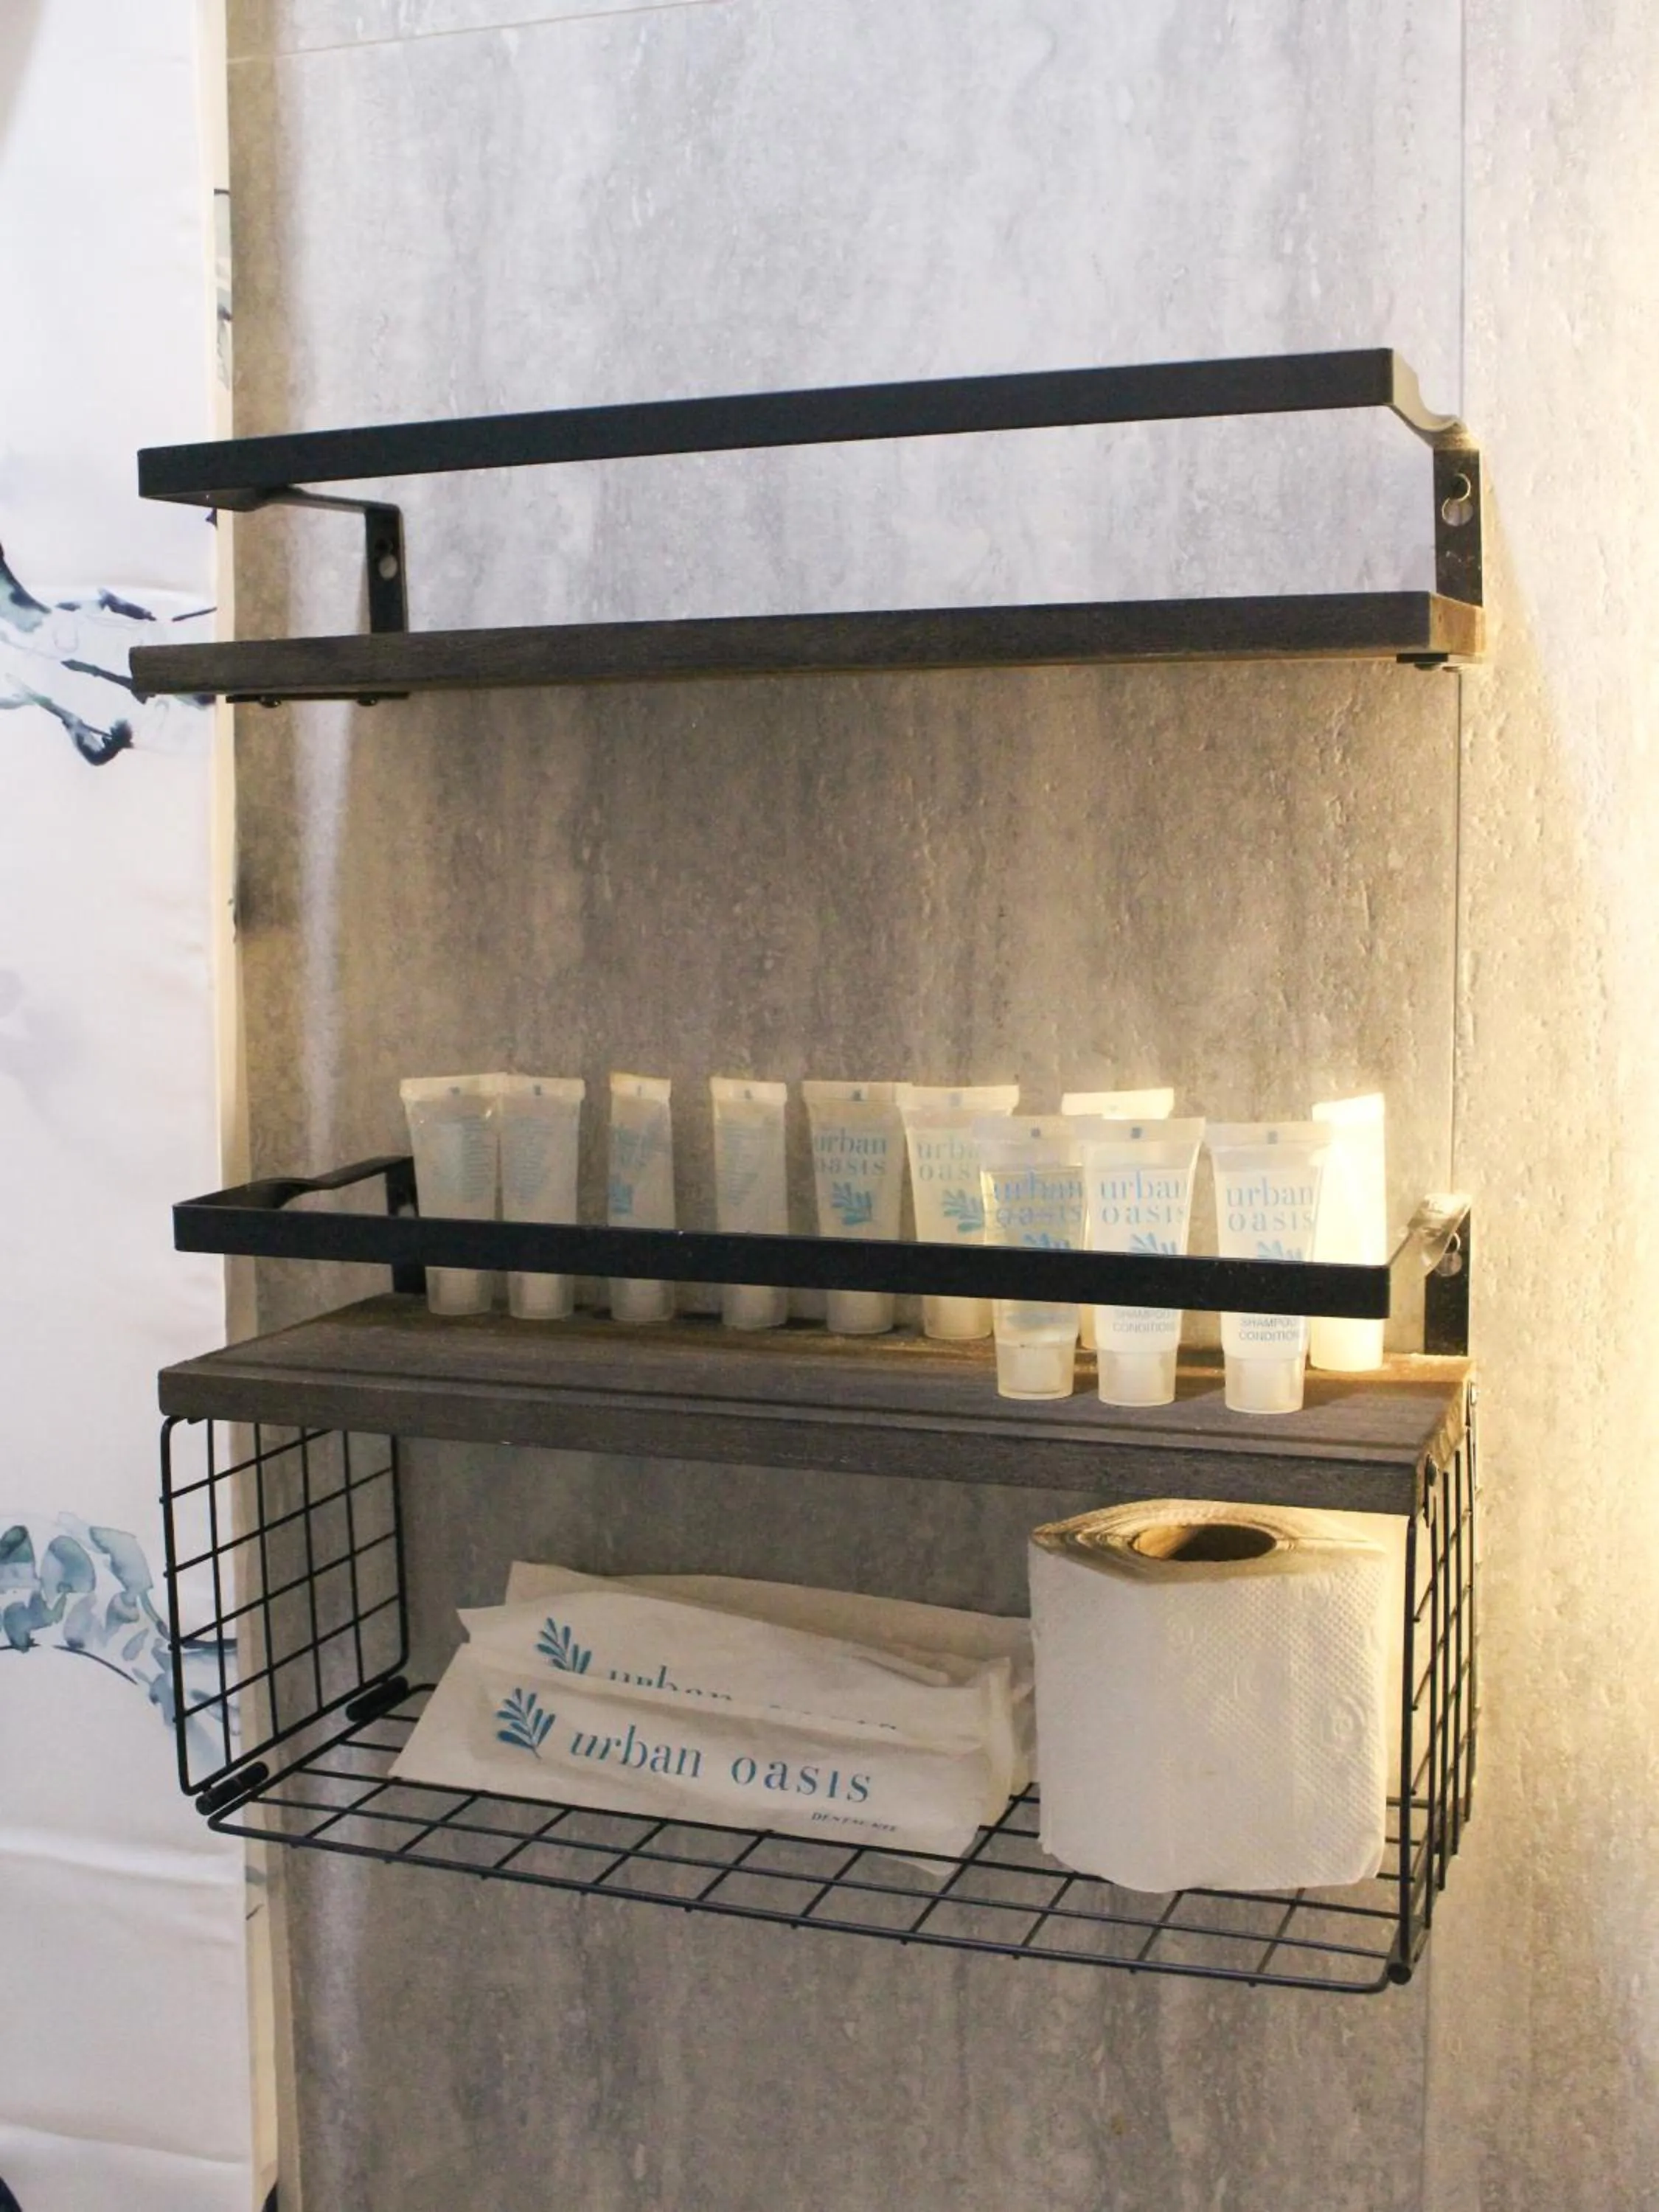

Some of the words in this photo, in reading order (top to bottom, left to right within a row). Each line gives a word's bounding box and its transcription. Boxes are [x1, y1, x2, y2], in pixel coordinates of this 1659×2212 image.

[814, 1127, 888, 1154] urban
[1226, 1177, 1315, 1207] urban
[1228, 1211, 1314, 1232] oasis
[570, 1725, 703, 1778] urban
[731, 1756, 872, 1803] oasis
